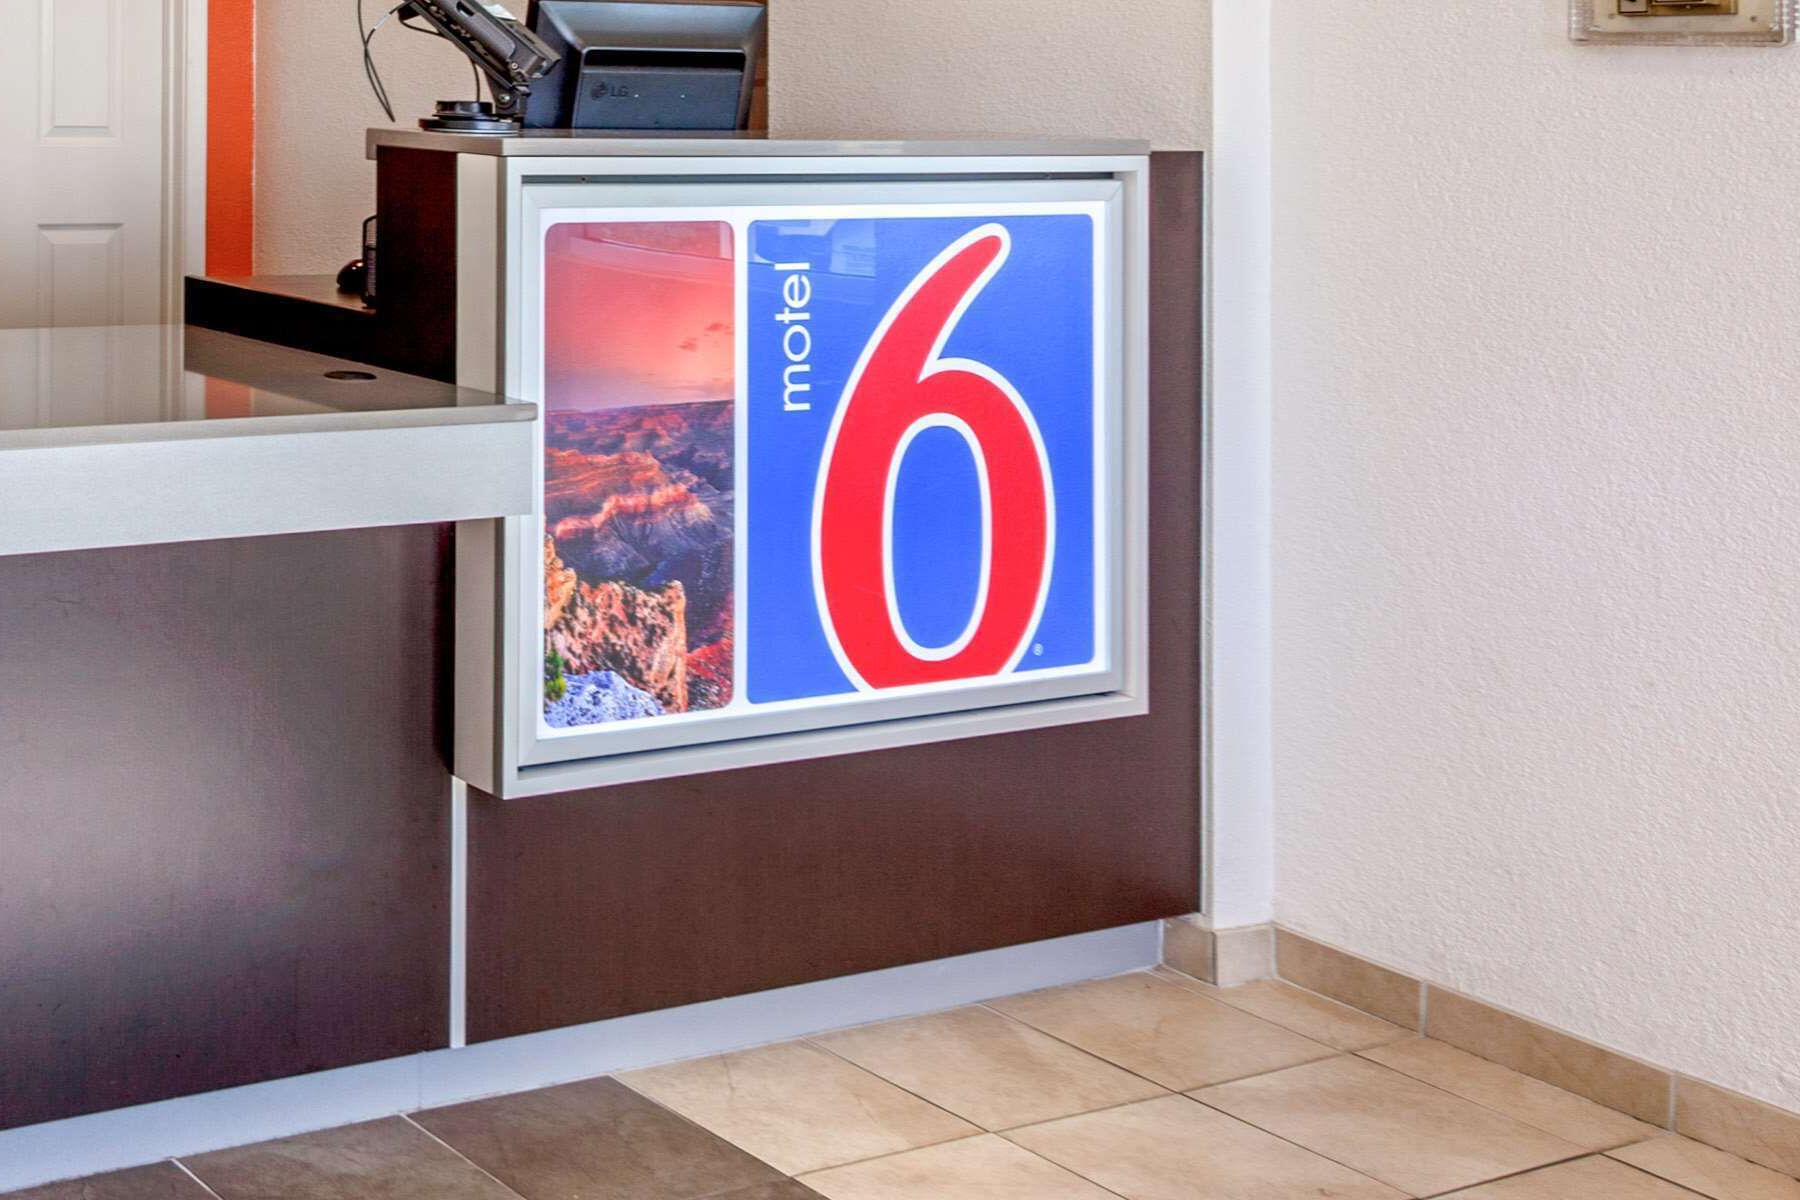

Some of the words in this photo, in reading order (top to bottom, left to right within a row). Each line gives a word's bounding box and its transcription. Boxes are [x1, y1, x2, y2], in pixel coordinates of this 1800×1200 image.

[610, 85, 629, 97] LG
[775, 261, 811, 412] motel
[810, 222, 1057, 694] 6
